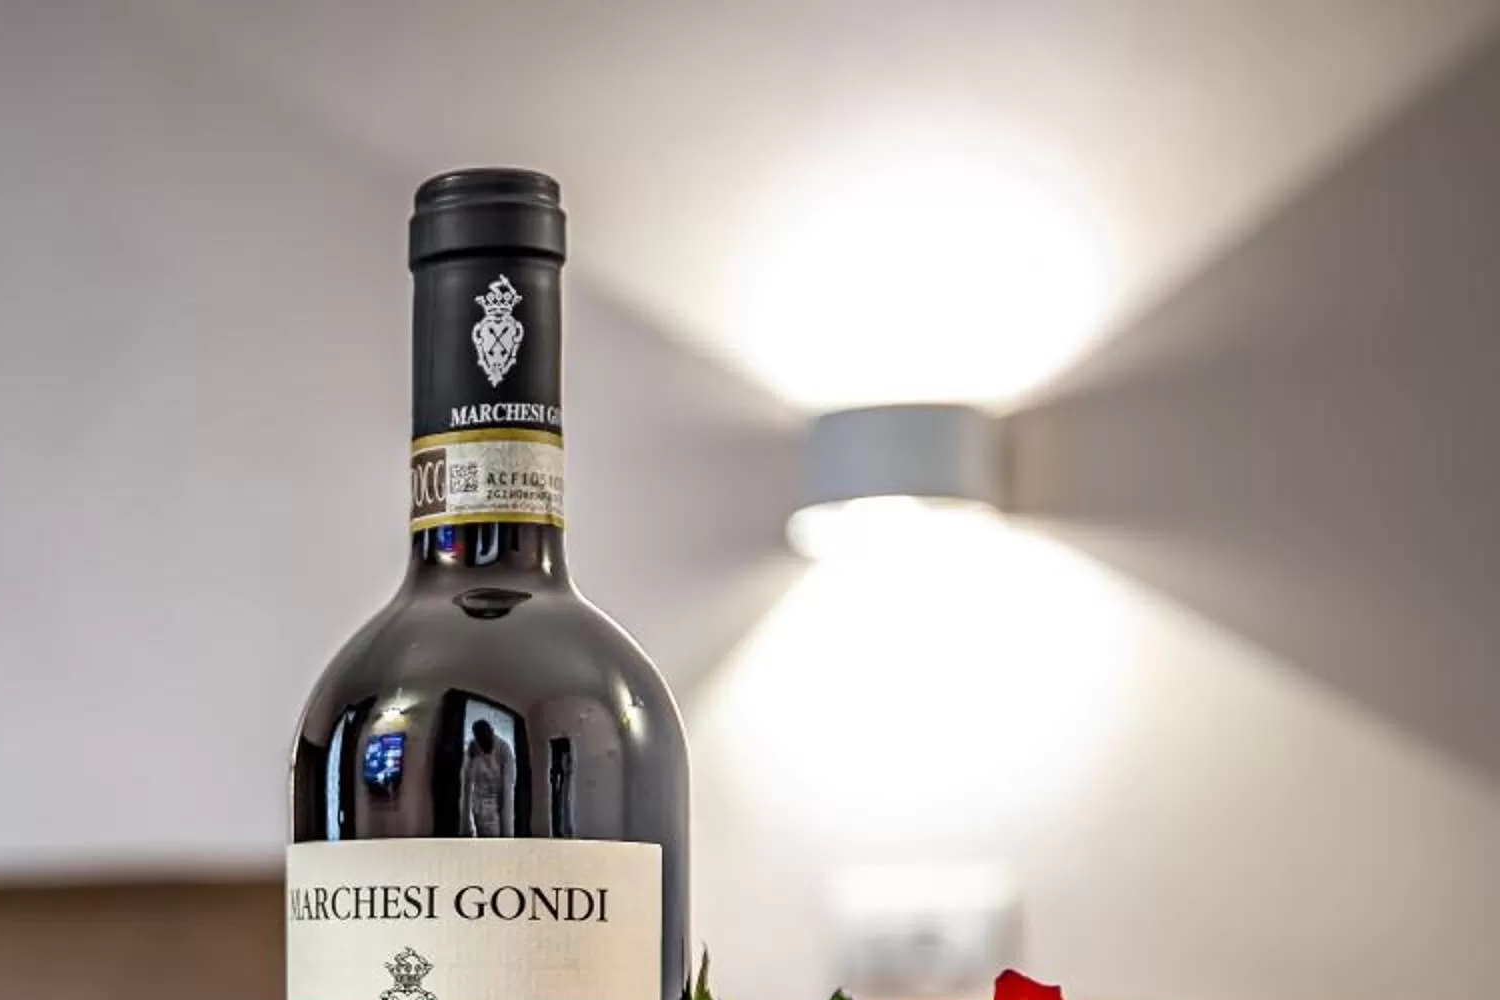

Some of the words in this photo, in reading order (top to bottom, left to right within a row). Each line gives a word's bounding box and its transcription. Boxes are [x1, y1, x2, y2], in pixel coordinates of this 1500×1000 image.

[450, 403, 545, 427] MARCHESI
[290, 885, 440, 921] MARCHESI
[454, 885, 609, 922] GONDI
